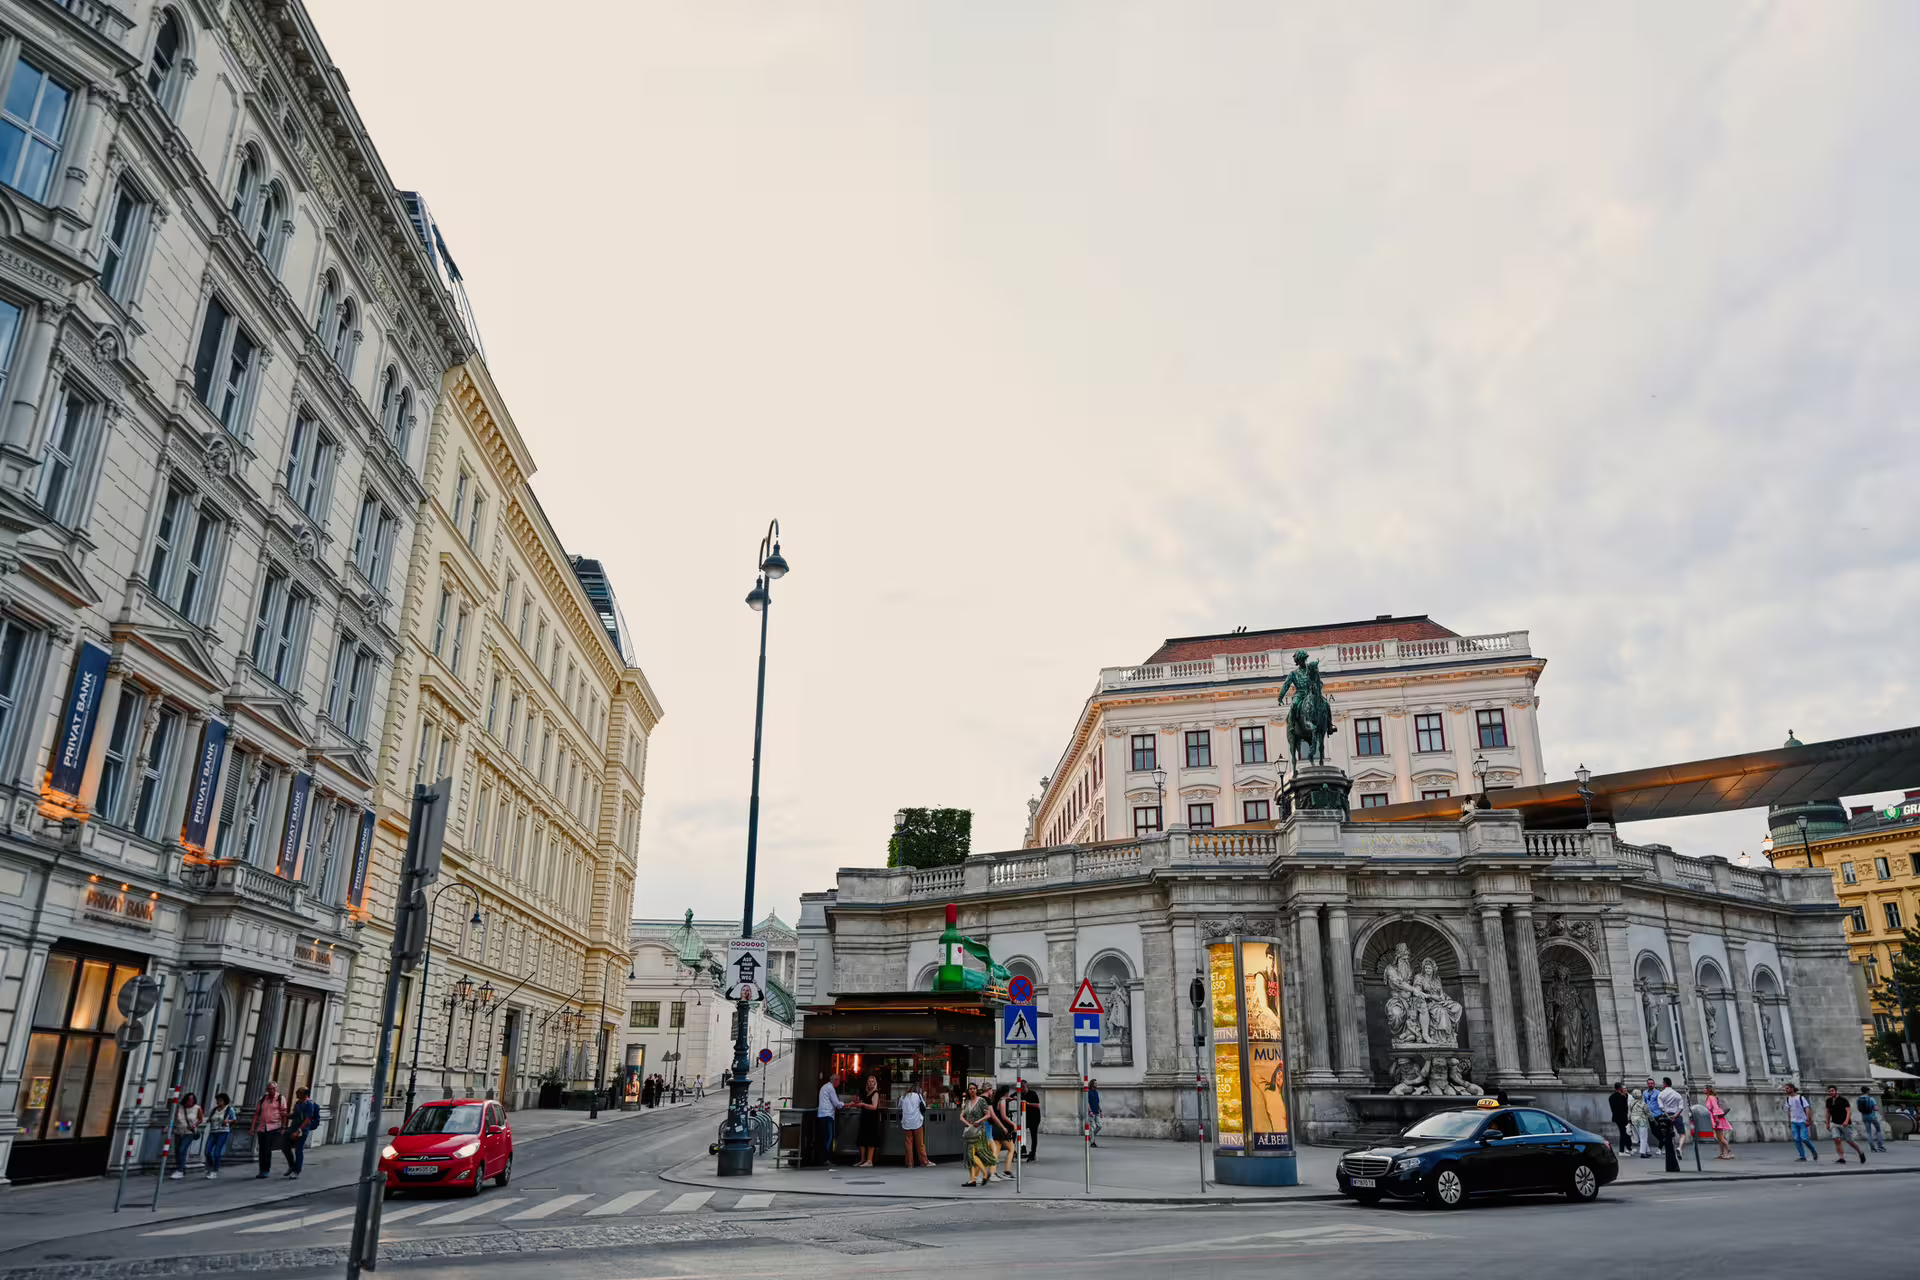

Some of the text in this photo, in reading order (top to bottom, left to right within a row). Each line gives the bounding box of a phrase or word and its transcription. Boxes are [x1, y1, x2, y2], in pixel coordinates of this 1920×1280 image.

[63, 713, 82, 767] PRIVAT
[76, 671, 92, 712] BANK
[194, 778, 208, 823] PRIVAT
[203, 741, 216, 776] BANK
[285, 821, 296, 862] PRIVAT
[292, 790, 302, 820] BANK
[354, 855, 363, 889] PRIVAT
[360, 827, 369, 854] BANK
[87, 889, 154, 920] PRIVAT BANK
[294, 945, 331, 965] PRIVAT BANK
